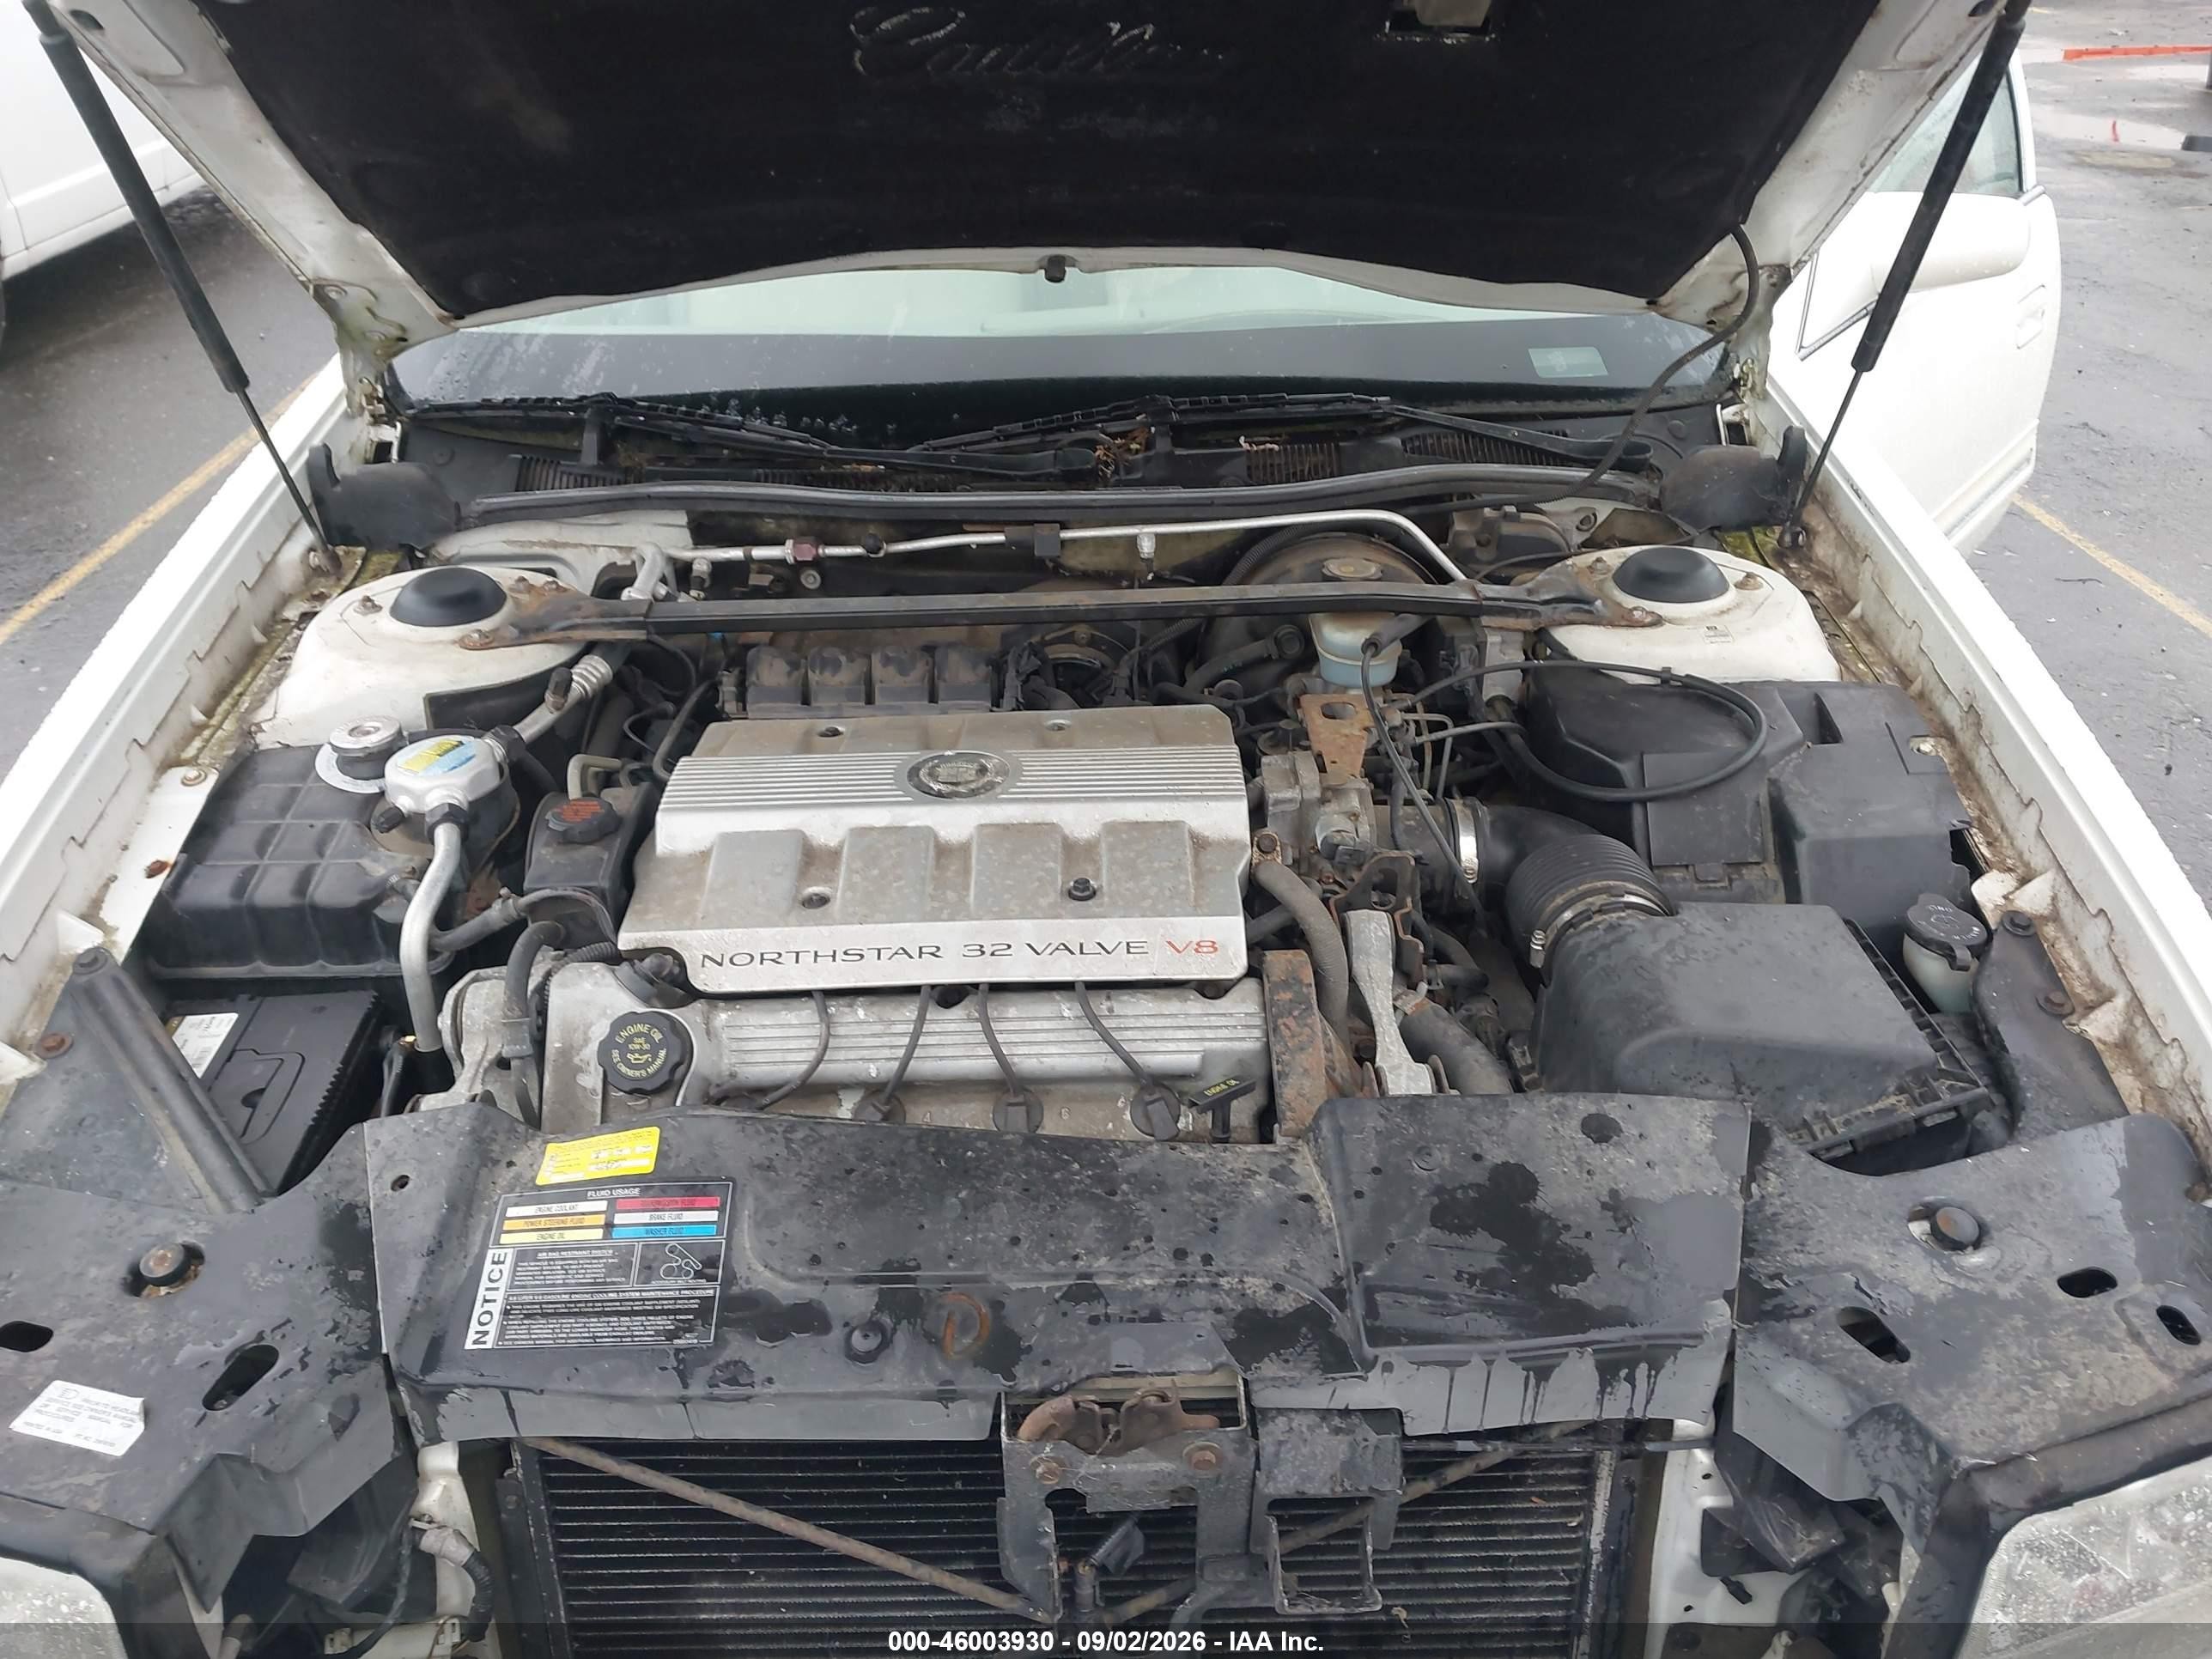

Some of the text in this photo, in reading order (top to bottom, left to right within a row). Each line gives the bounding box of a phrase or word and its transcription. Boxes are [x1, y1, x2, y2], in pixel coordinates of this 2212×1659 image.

[701, 939, 1219, 968] NORTHSTAR 32 VALVE V8
[616, 1024, 663, 1043] ENGINE OIL
[586, 1188, 641, 1199] FLUID USAGE
[471, 1250, 508, 1346] NOTICE
